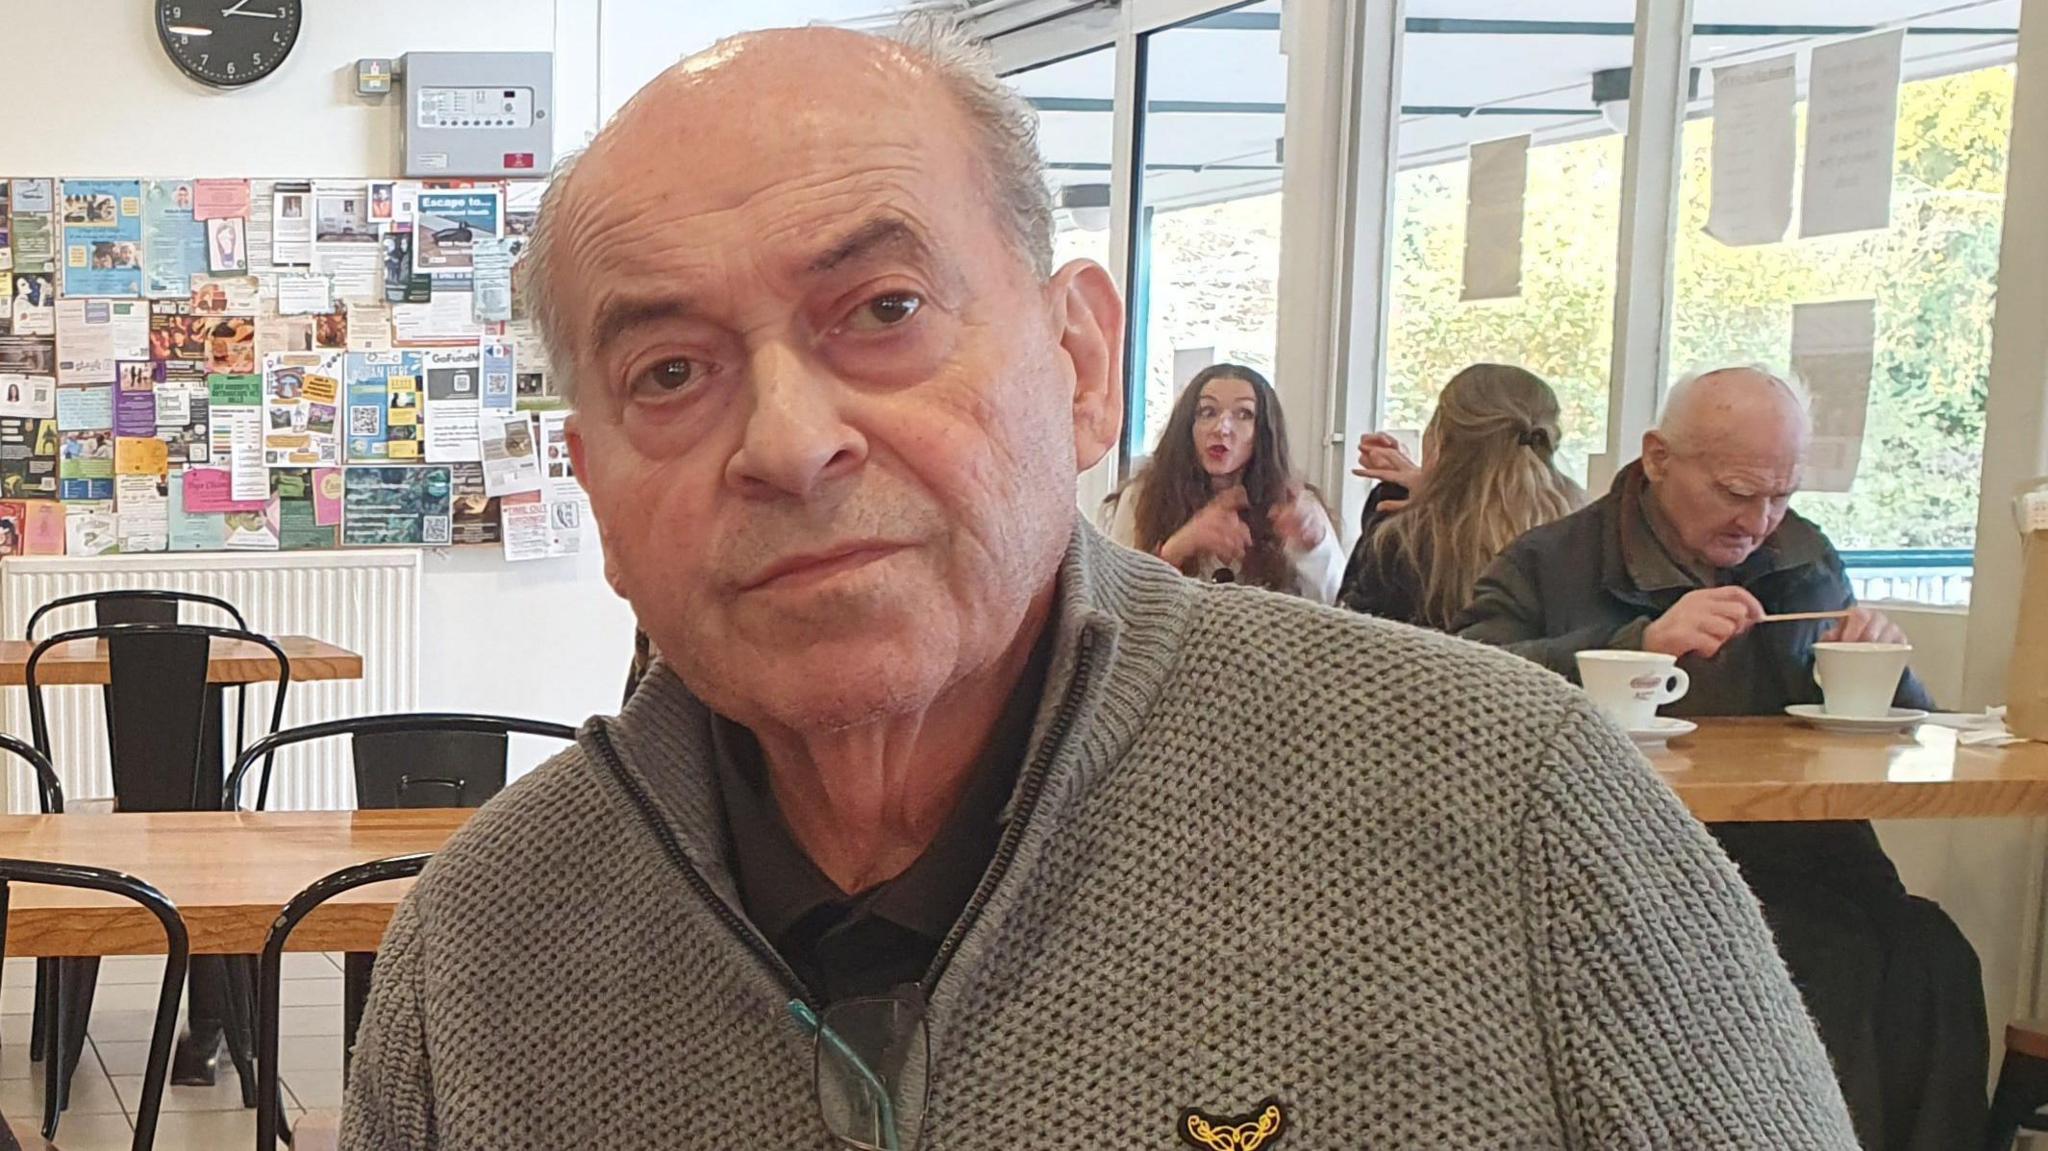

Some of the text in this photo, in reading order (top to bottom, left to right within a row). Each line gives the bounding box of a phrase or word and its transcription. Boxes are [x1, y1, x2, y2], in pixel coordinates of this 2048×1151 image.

[173, 7, 181, 18] 9
[278, 7, 286, 18] 3
[273, 32, 280, 43] 4
[201, 54, 209, 65] 7
[253, 53, 261, 65] 5
[227, 63, 235, 74] 6
[422, 197, 466, 210] Escape
